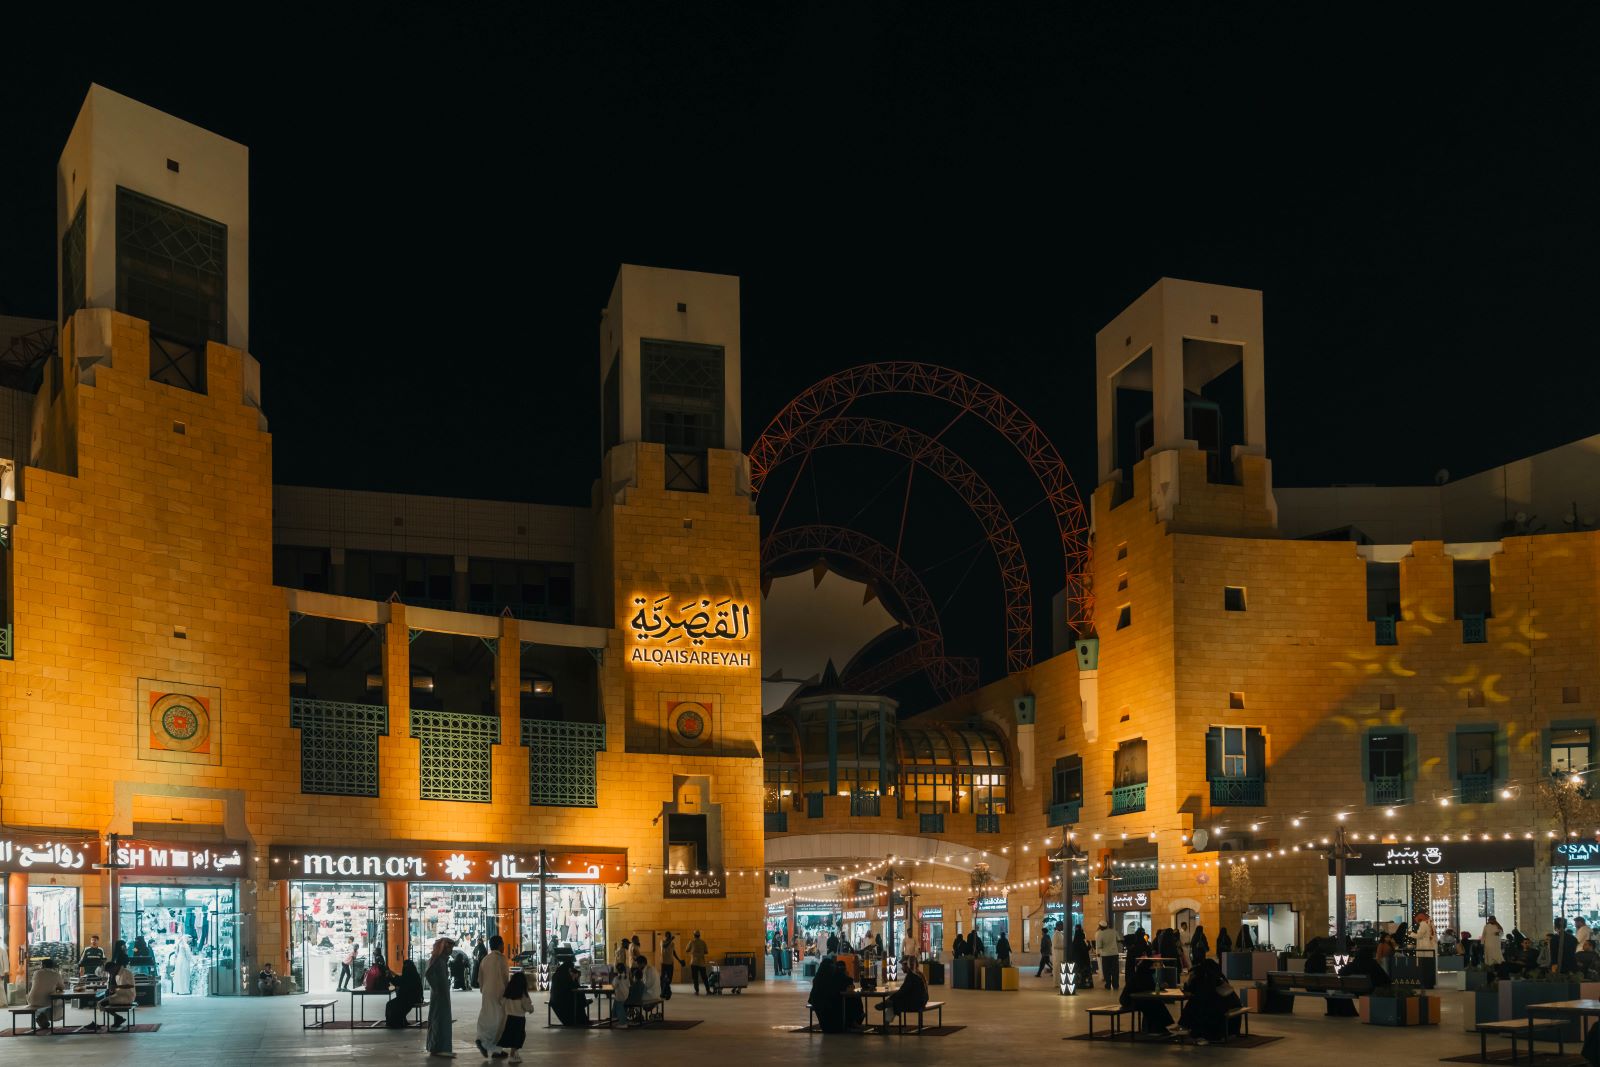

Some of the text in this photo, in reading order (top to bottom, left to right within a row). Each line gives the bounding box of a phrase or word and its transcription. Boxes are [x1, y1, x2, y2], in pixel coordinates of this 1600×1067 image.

[632, 648, 751, 667] ALQAISAREYAH
[303, 853, 427, 877] manar
[489, 854, 600, 879] منار
